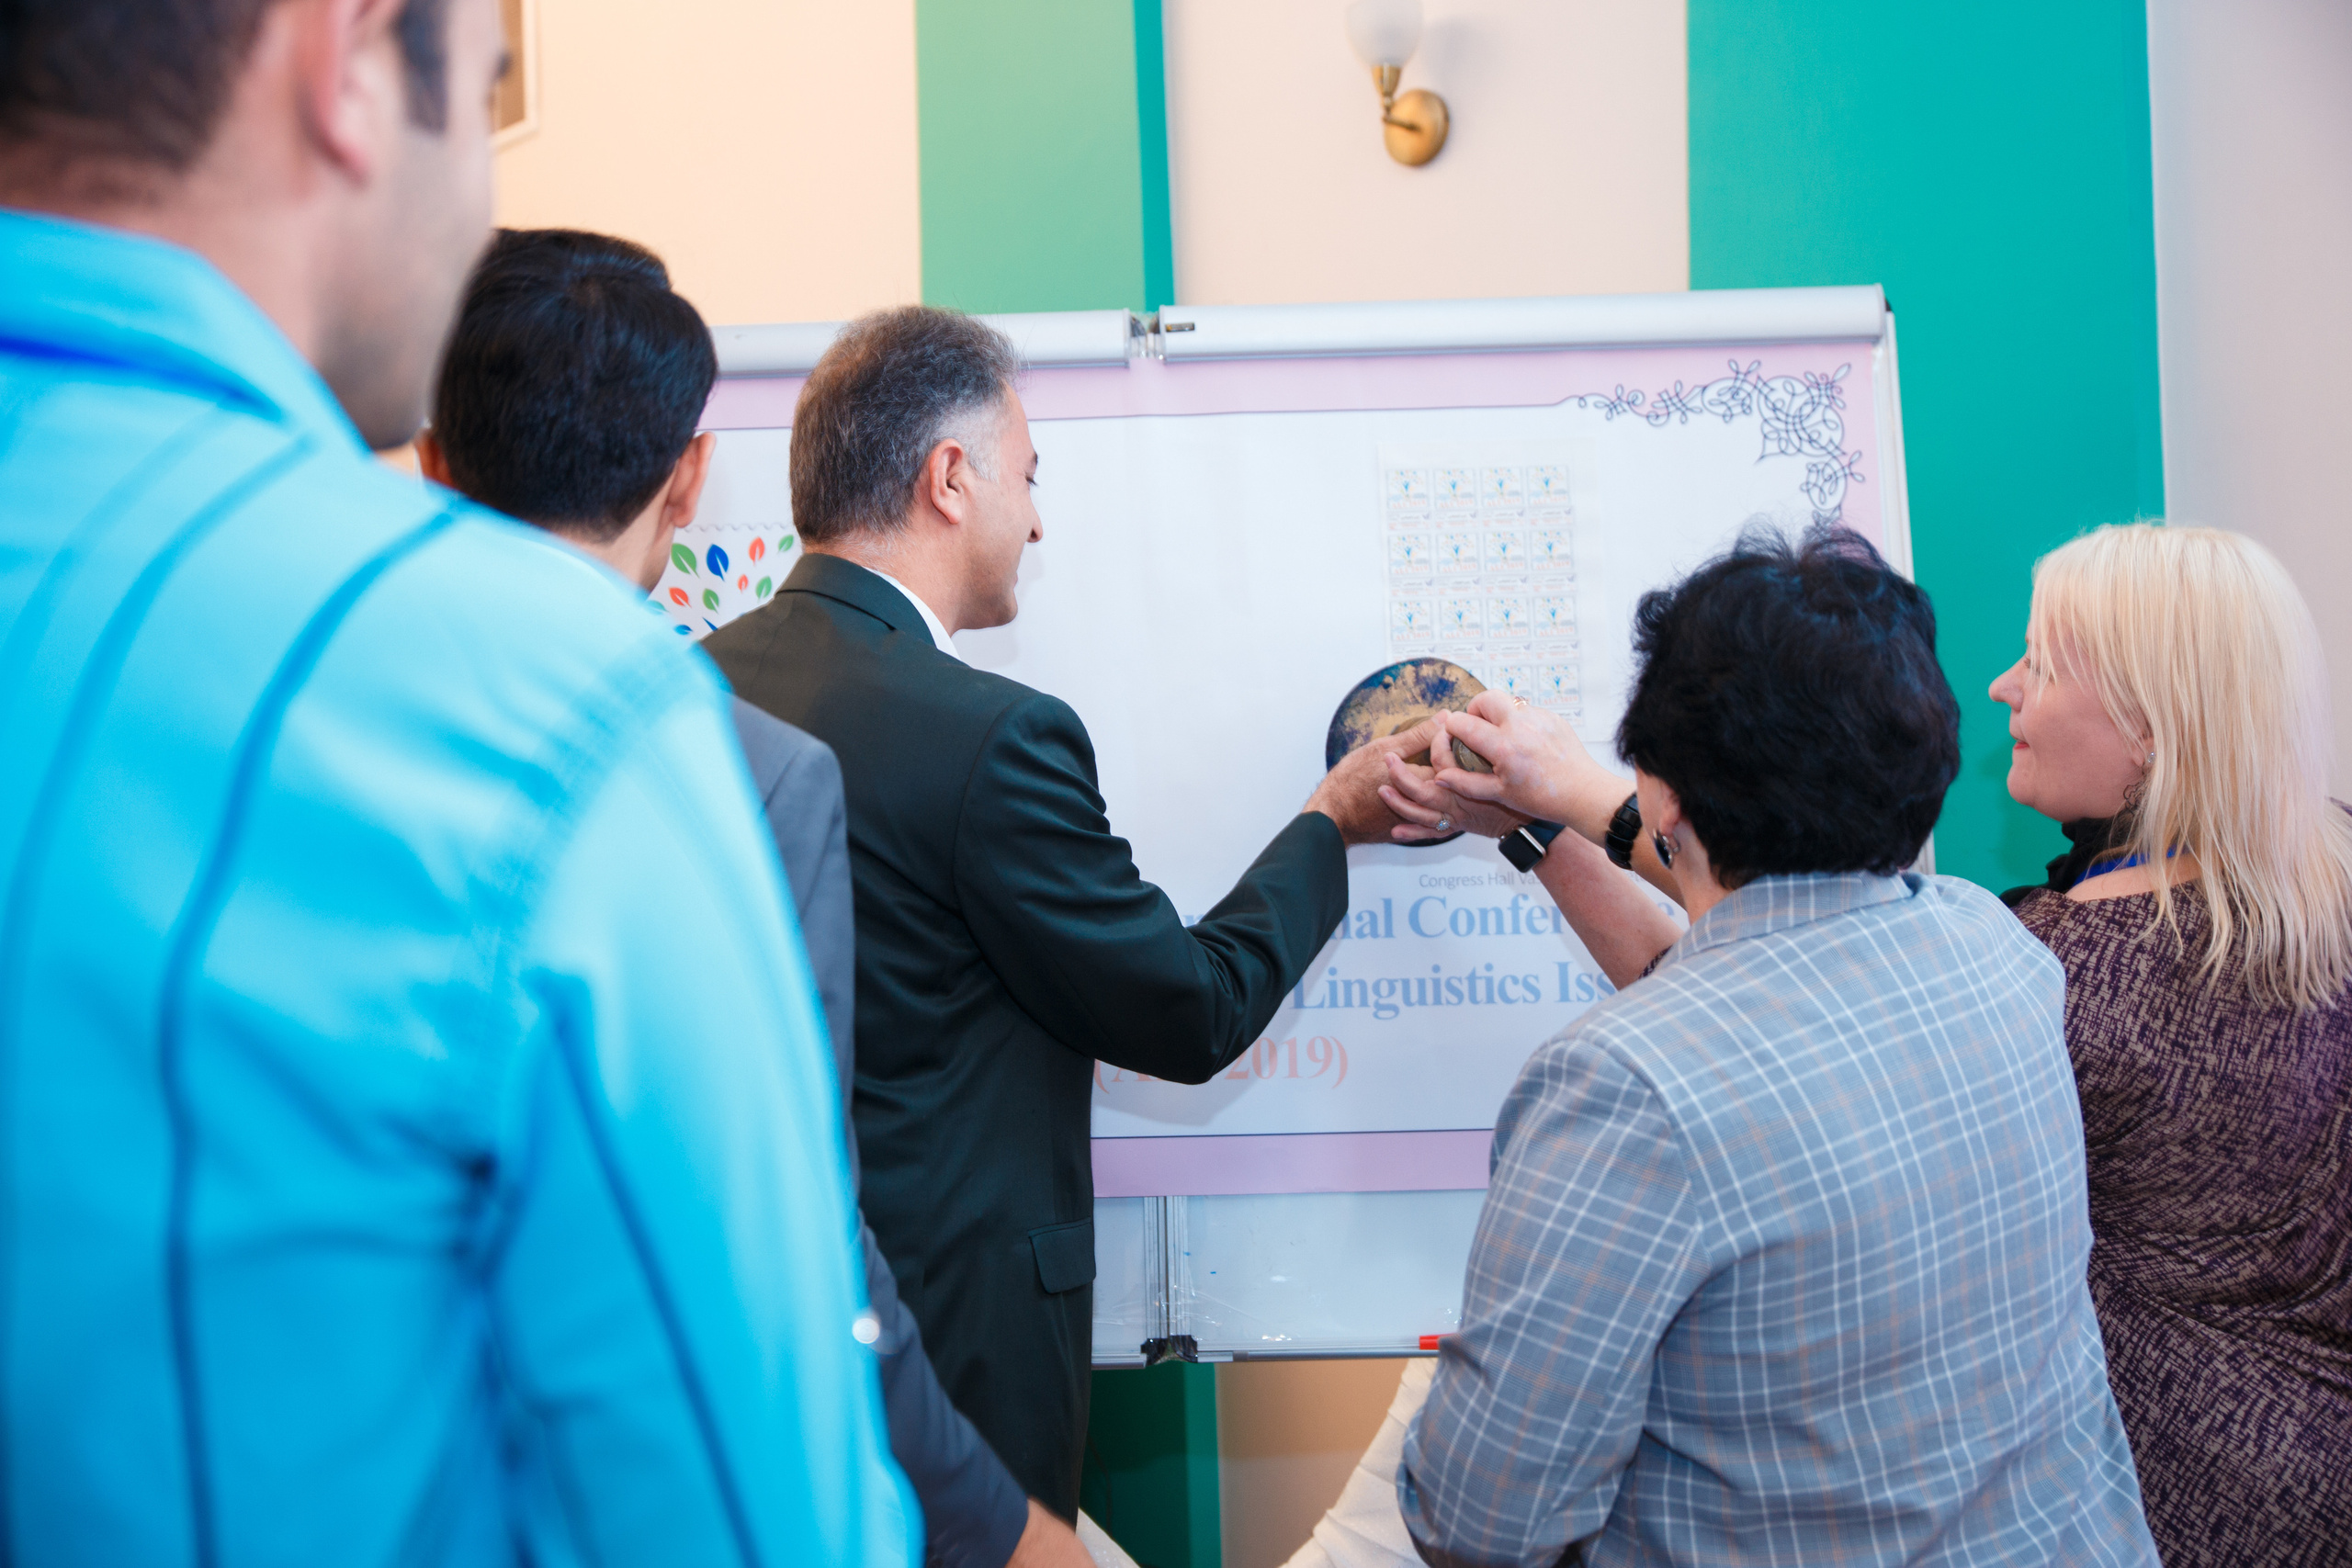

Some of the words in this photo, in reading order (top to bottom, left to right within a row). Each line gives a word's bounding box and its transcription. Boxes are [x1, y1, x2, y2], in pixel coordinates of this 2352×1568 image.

[1419, 874, 1485, 889] Congress
[1487, 872, 1515, 885] Hall
[1408, 893, 1564, 939] Confer
[1289, 963, 1542, 1021] Linguistics
[1552, 961, 1616, 1003] Iss
